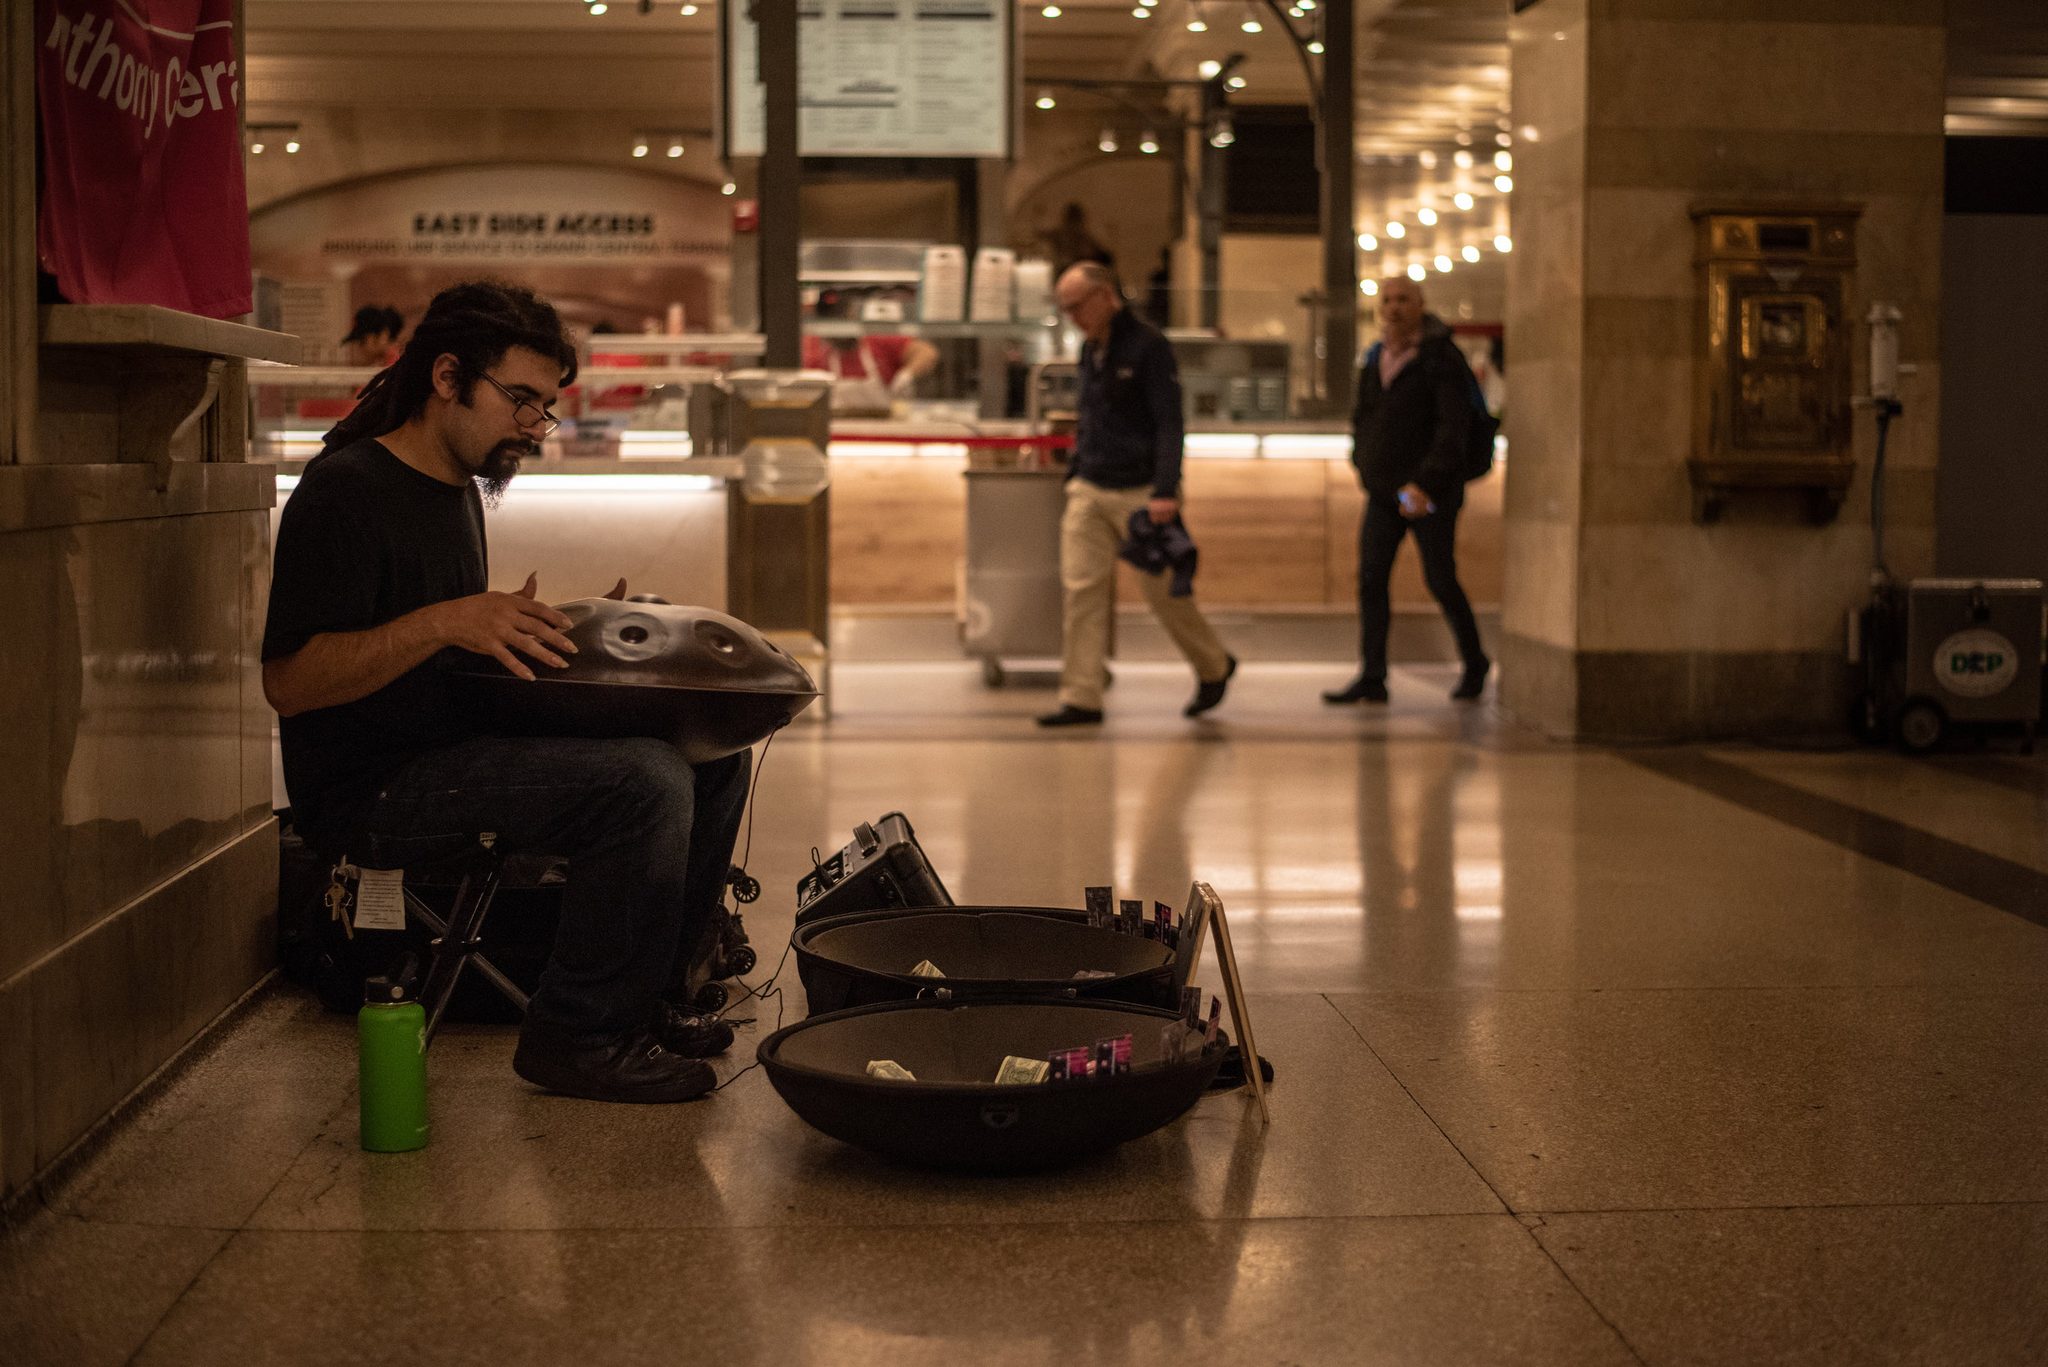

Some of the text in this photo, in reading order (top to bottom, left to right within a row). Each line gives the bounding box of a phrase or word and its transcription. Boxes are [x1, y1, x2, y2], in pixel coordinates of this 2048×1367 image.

[413, 212, 654, 235] EAST SIDE ACCESS
